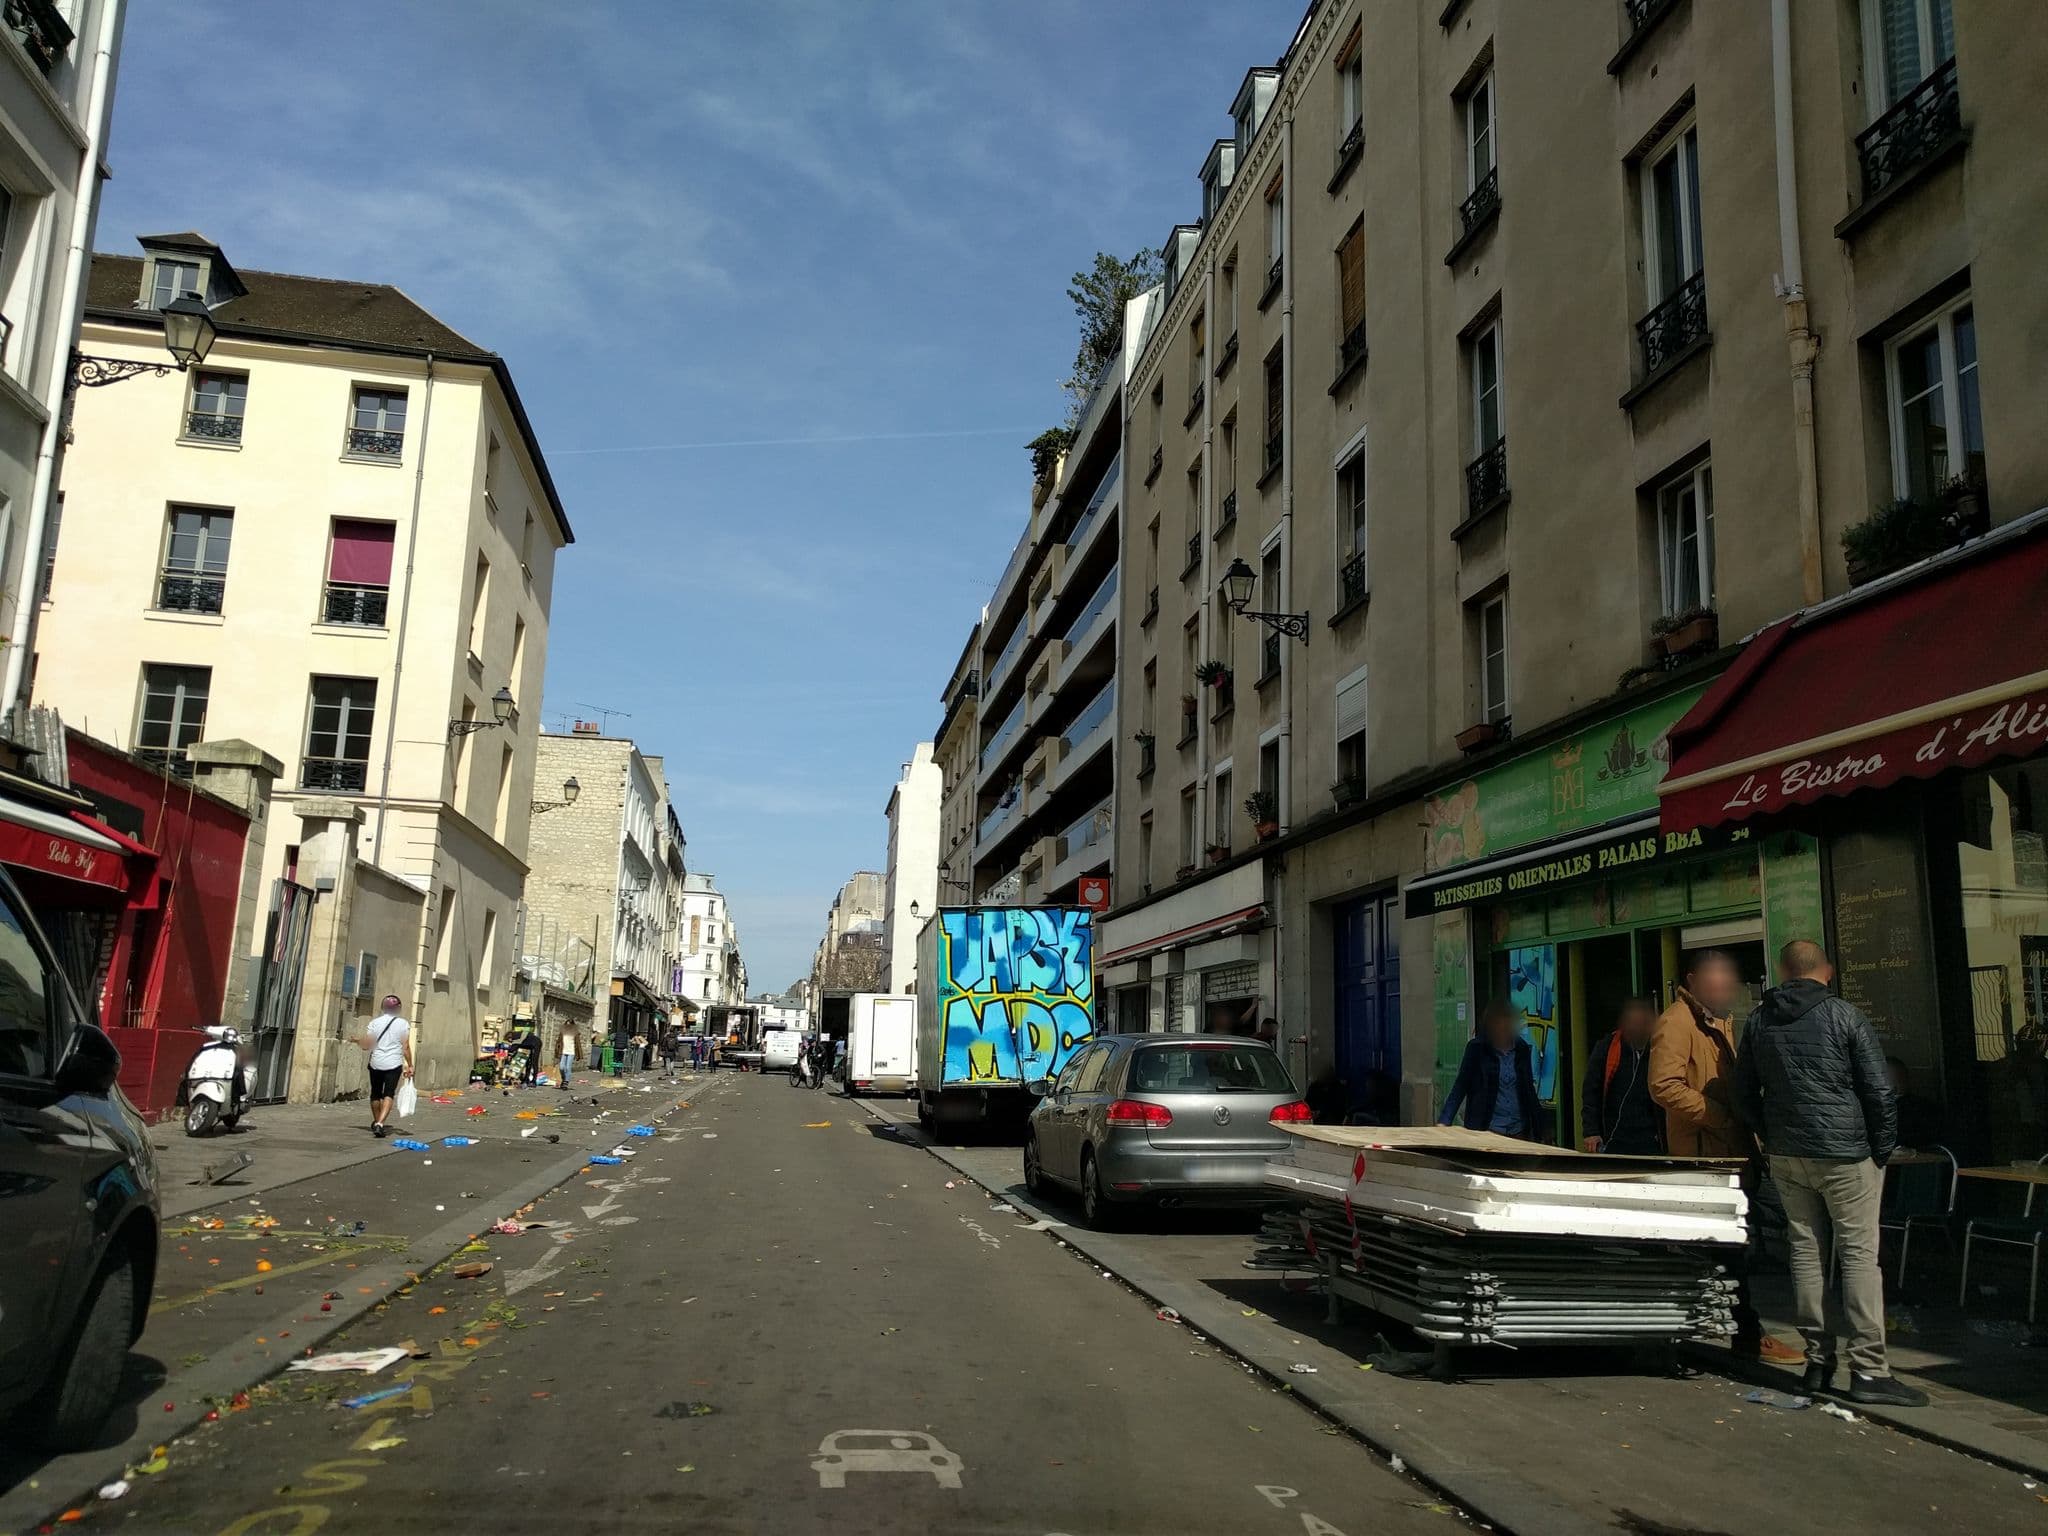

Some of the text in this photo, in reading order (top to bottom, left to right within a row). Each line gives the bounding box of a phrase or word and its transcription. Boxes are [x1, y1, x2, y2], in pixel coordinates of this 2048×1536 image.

[1722, 702, 2048, 812] Le Bistro d'Ali
[47, 840, 73, 865] Loto
[1434, 827, 1703, 907] PATISSERIES ORIENTALES PALAIS BBA
